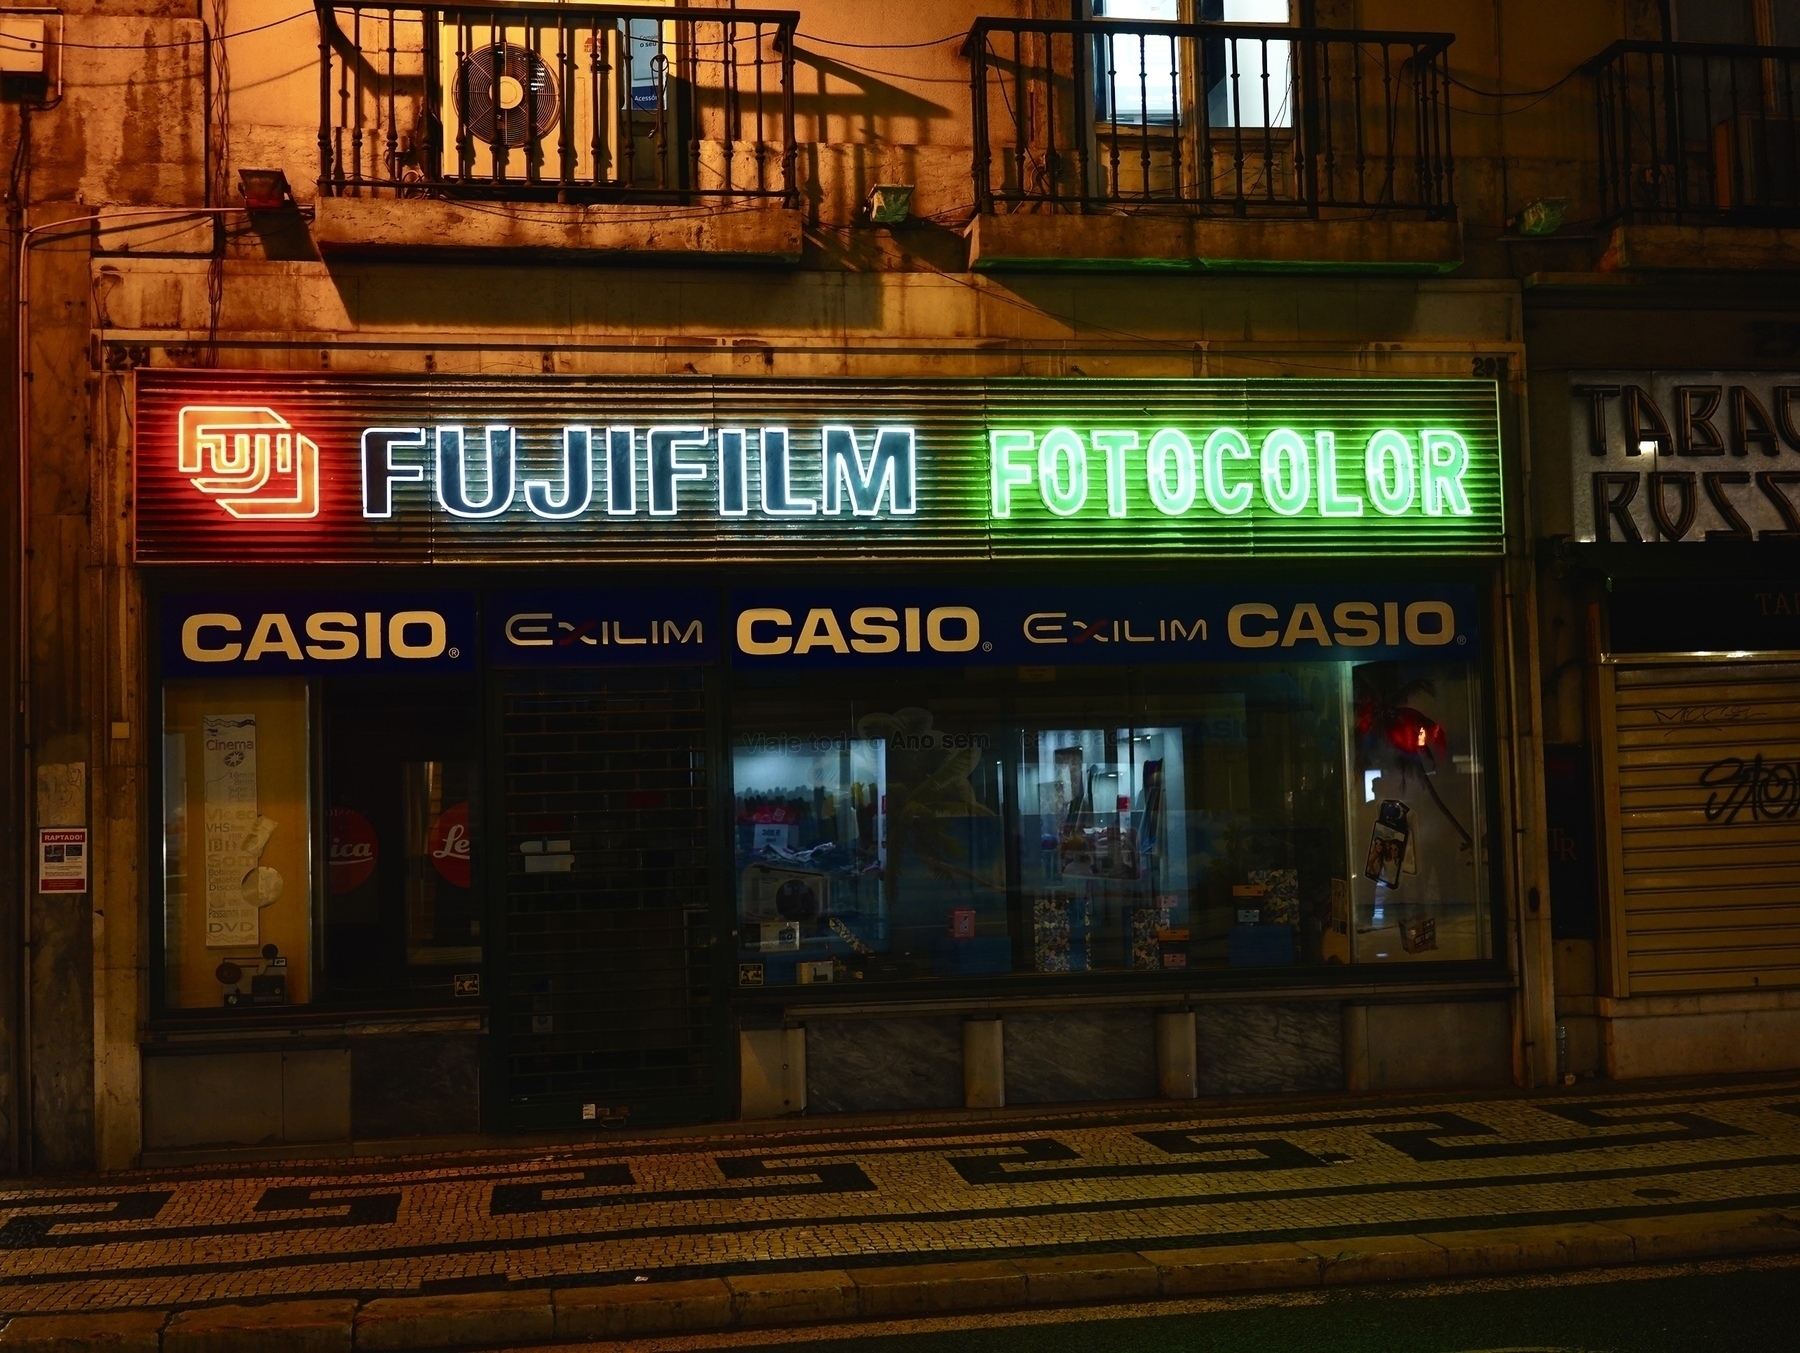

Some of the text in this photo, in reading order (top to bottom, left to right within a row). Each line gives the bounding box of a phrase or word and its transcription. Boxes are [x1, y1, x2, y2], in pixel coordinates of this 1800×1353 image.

[178, 405, 300, 500] FUJI
[360, 424, 1473, 519] FUJIFILM FOTOCOLOR
[505, 612, 703, 647] EXILIM
[1023, 612, 1207, 645] EXILIM
[206, 739, 255, 752] Cinema
[741, 732, 803, 759] Viaje
[808, 730, 861, 753] todo
[889, 729, 936, 752] Ano
[941, 731, 991, 751] sem
[206, 822, 230, 833] VHS
[44, 834, 83, 842] RAPTADO!
[209, 883, 241, 892] Discos
[208, 908, 239, 919] Passamos
[209, 921, 255, 933] DVD
